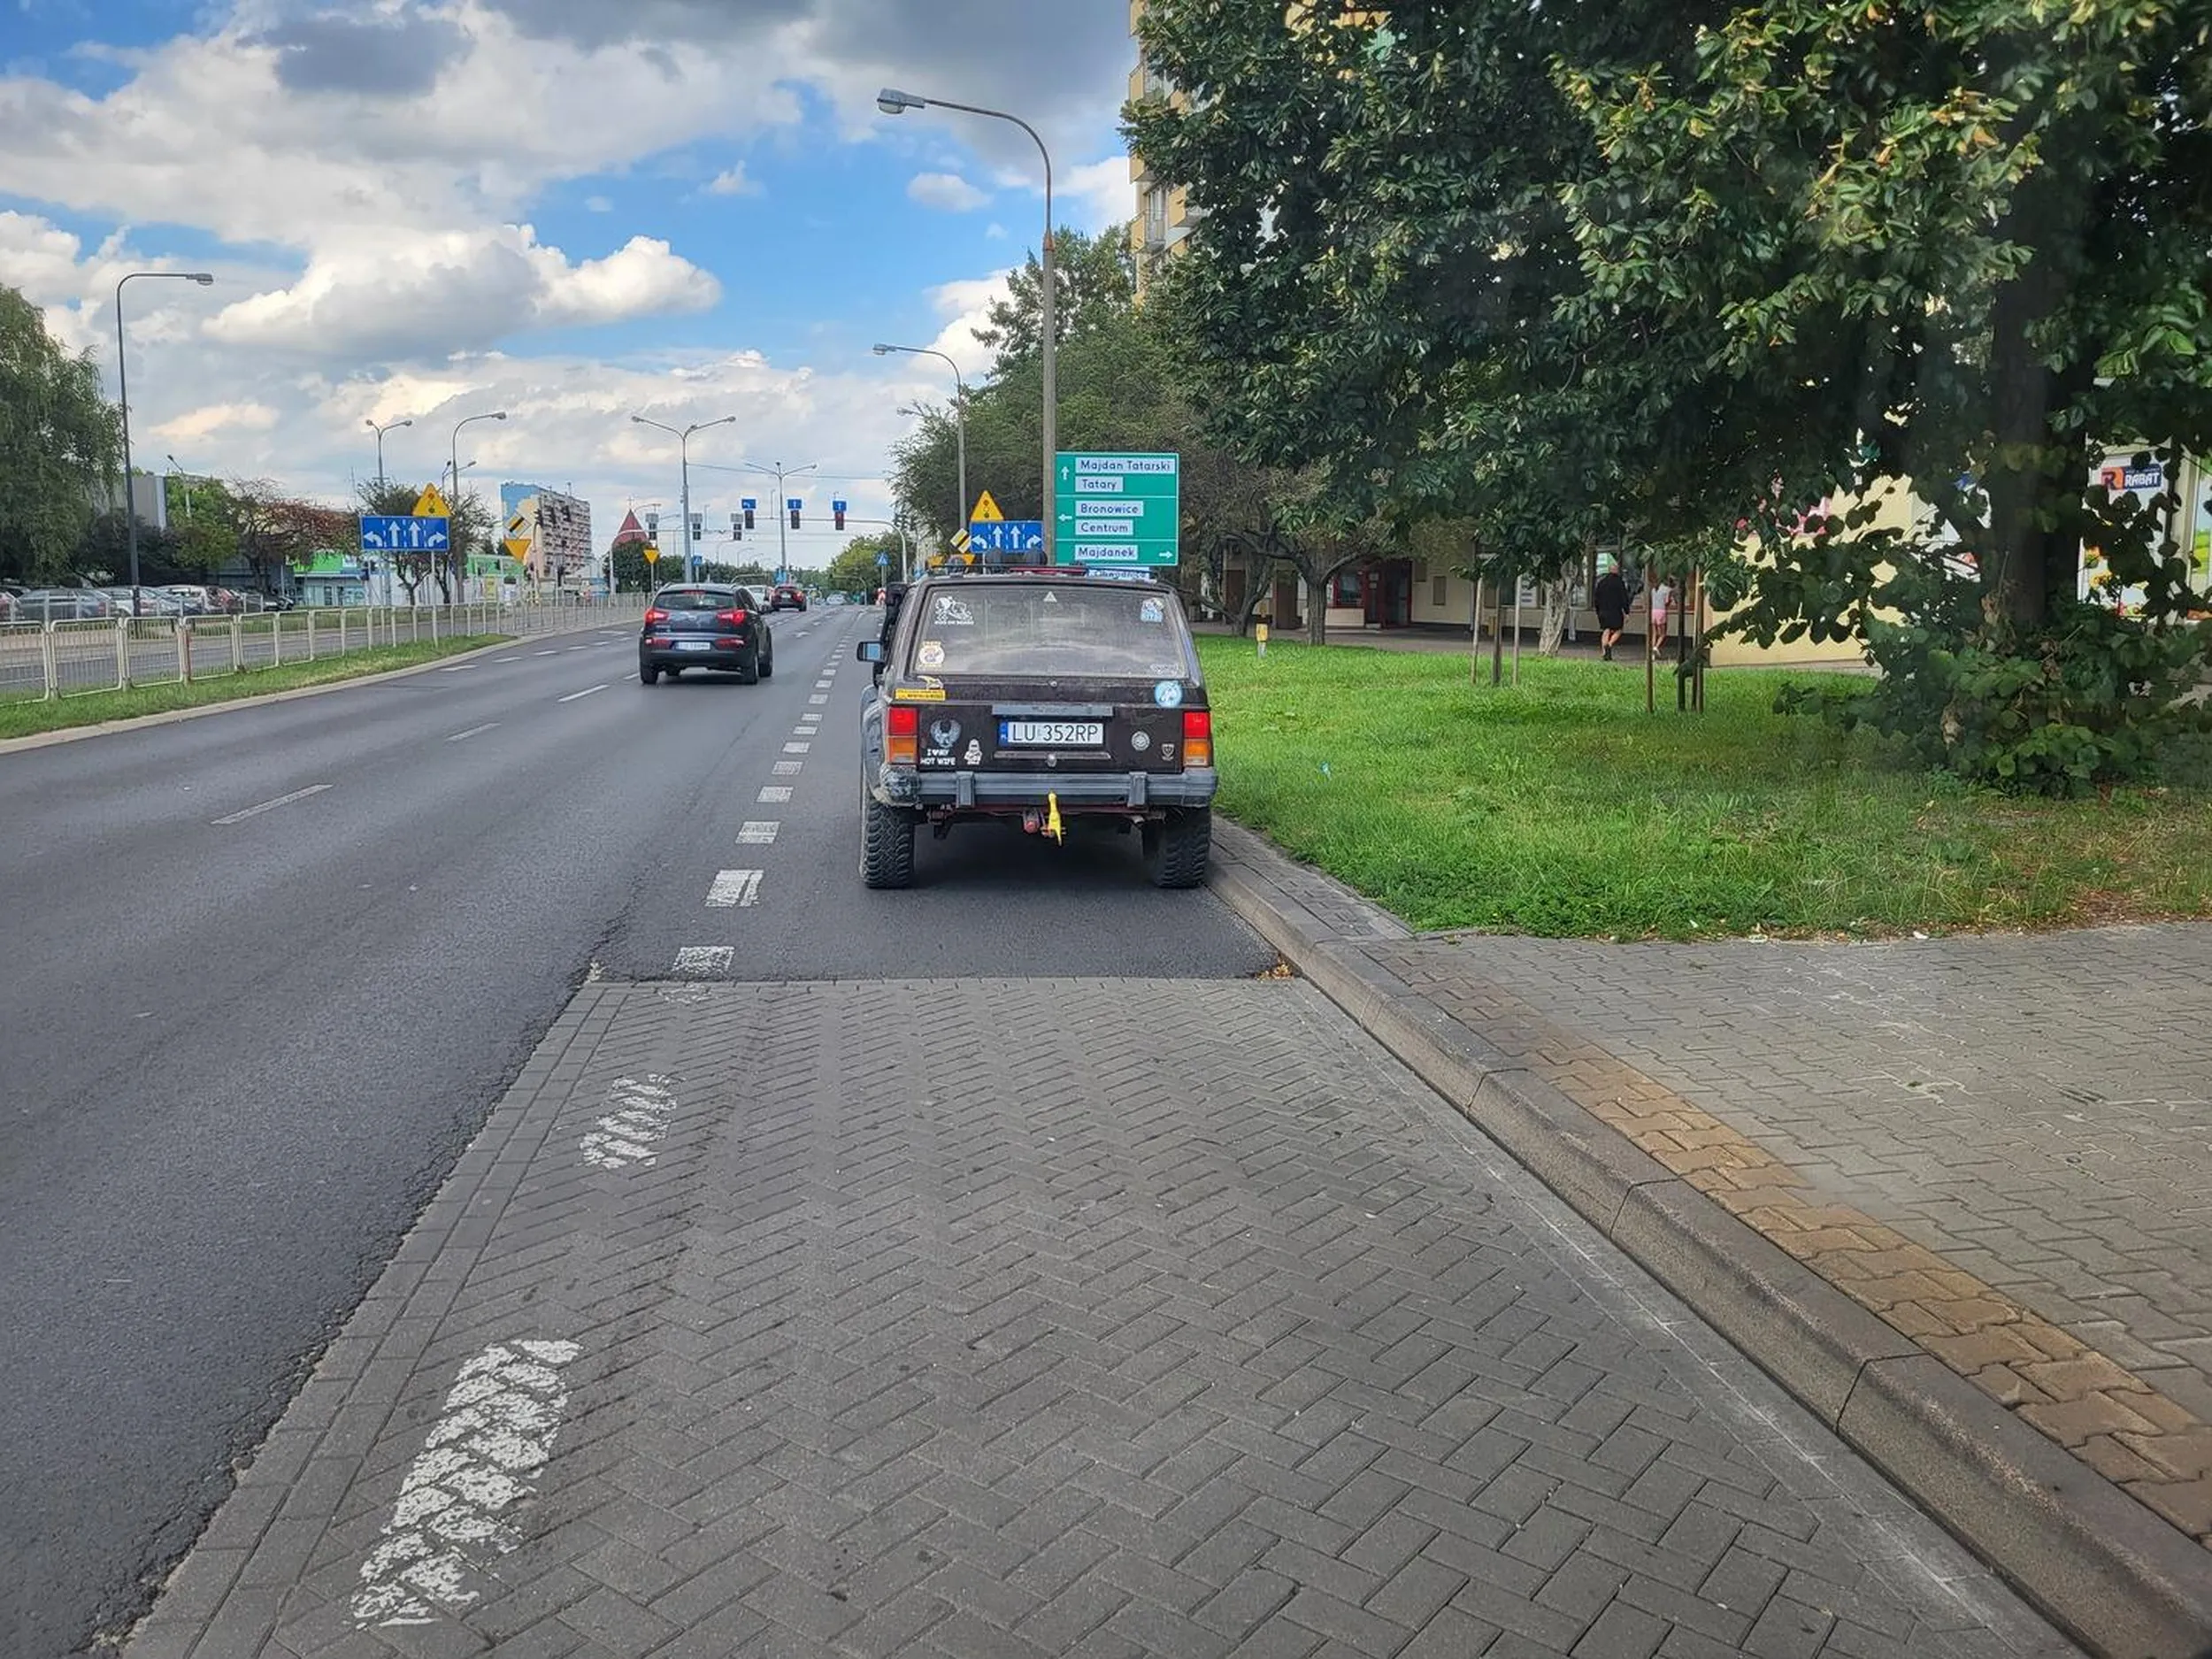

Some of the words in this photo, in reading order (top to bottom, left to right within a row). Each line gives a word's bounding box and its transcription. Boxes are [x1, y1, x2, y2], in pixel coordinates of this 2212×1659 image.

[1080, 460, 1123, 472] Majdan
[1127, 460, 1171, 472] Tatarski
[1082, 479, 1117, 490] Tatary
[2125, 472, 2159, 487] RABAT
[1080, 503, 1139, 514] Bronowice
[1080, 522, 1128, 532] Centrum
[1079, 547, 1135, 558] Majdanek
[1013, 724, 1035, 741] LU
[1043, 725, 1098, 741] 352RP
